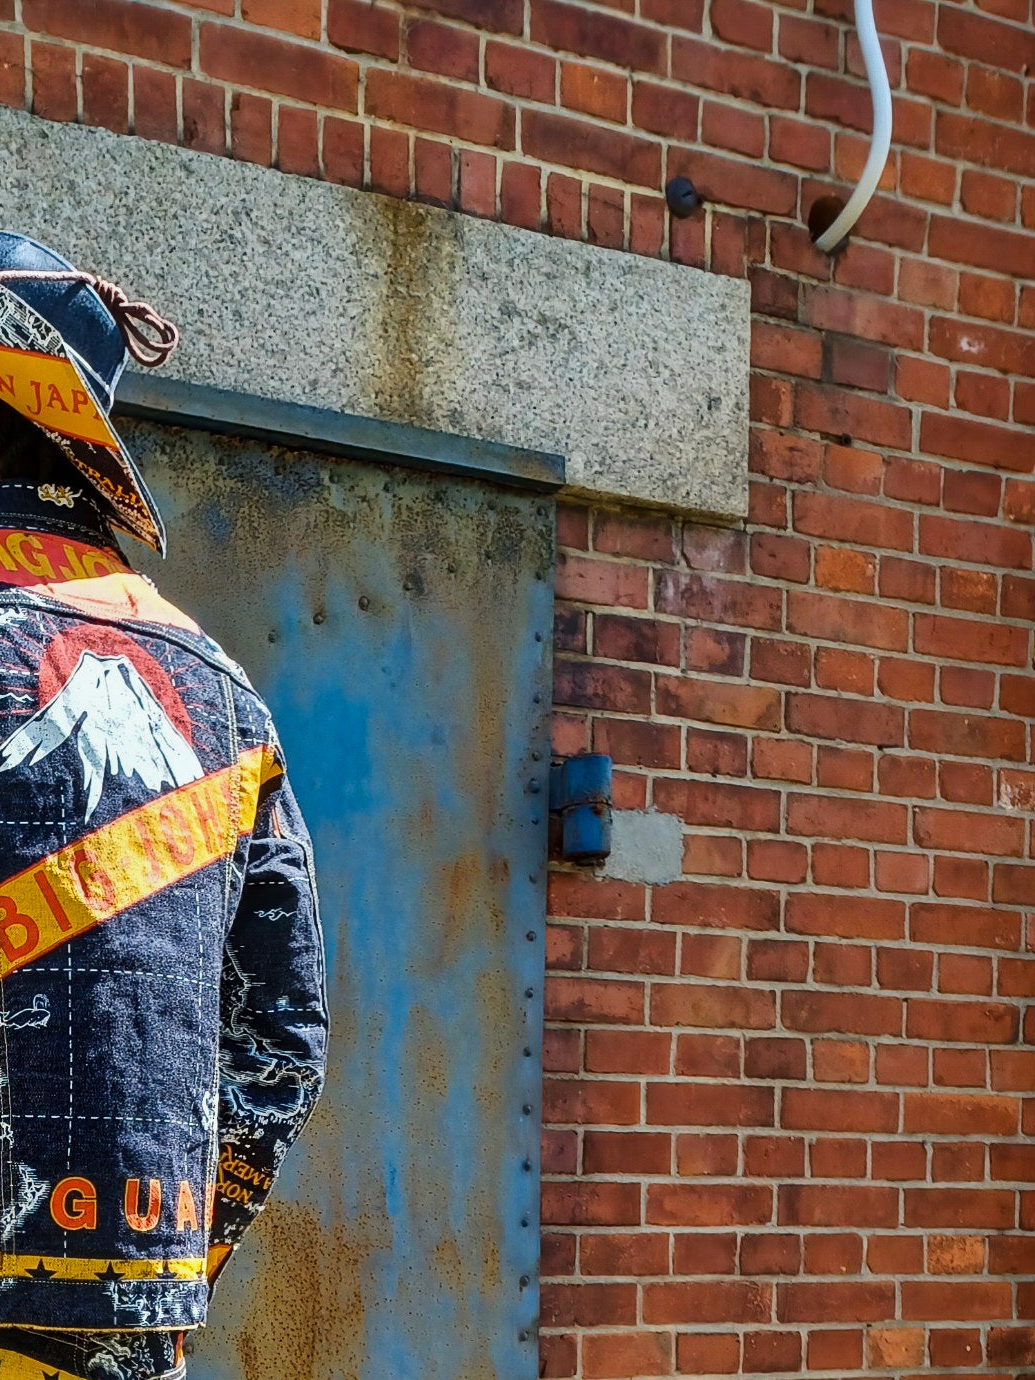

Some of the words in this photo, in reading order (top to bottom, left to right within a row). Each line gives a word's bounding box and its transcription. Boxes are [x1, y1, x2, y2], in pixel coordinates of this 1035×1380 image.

[26, 380, 102, 421] JAP
[59, 543, 120, 581] JO
[50, 1176, 214, 1232] GUA
